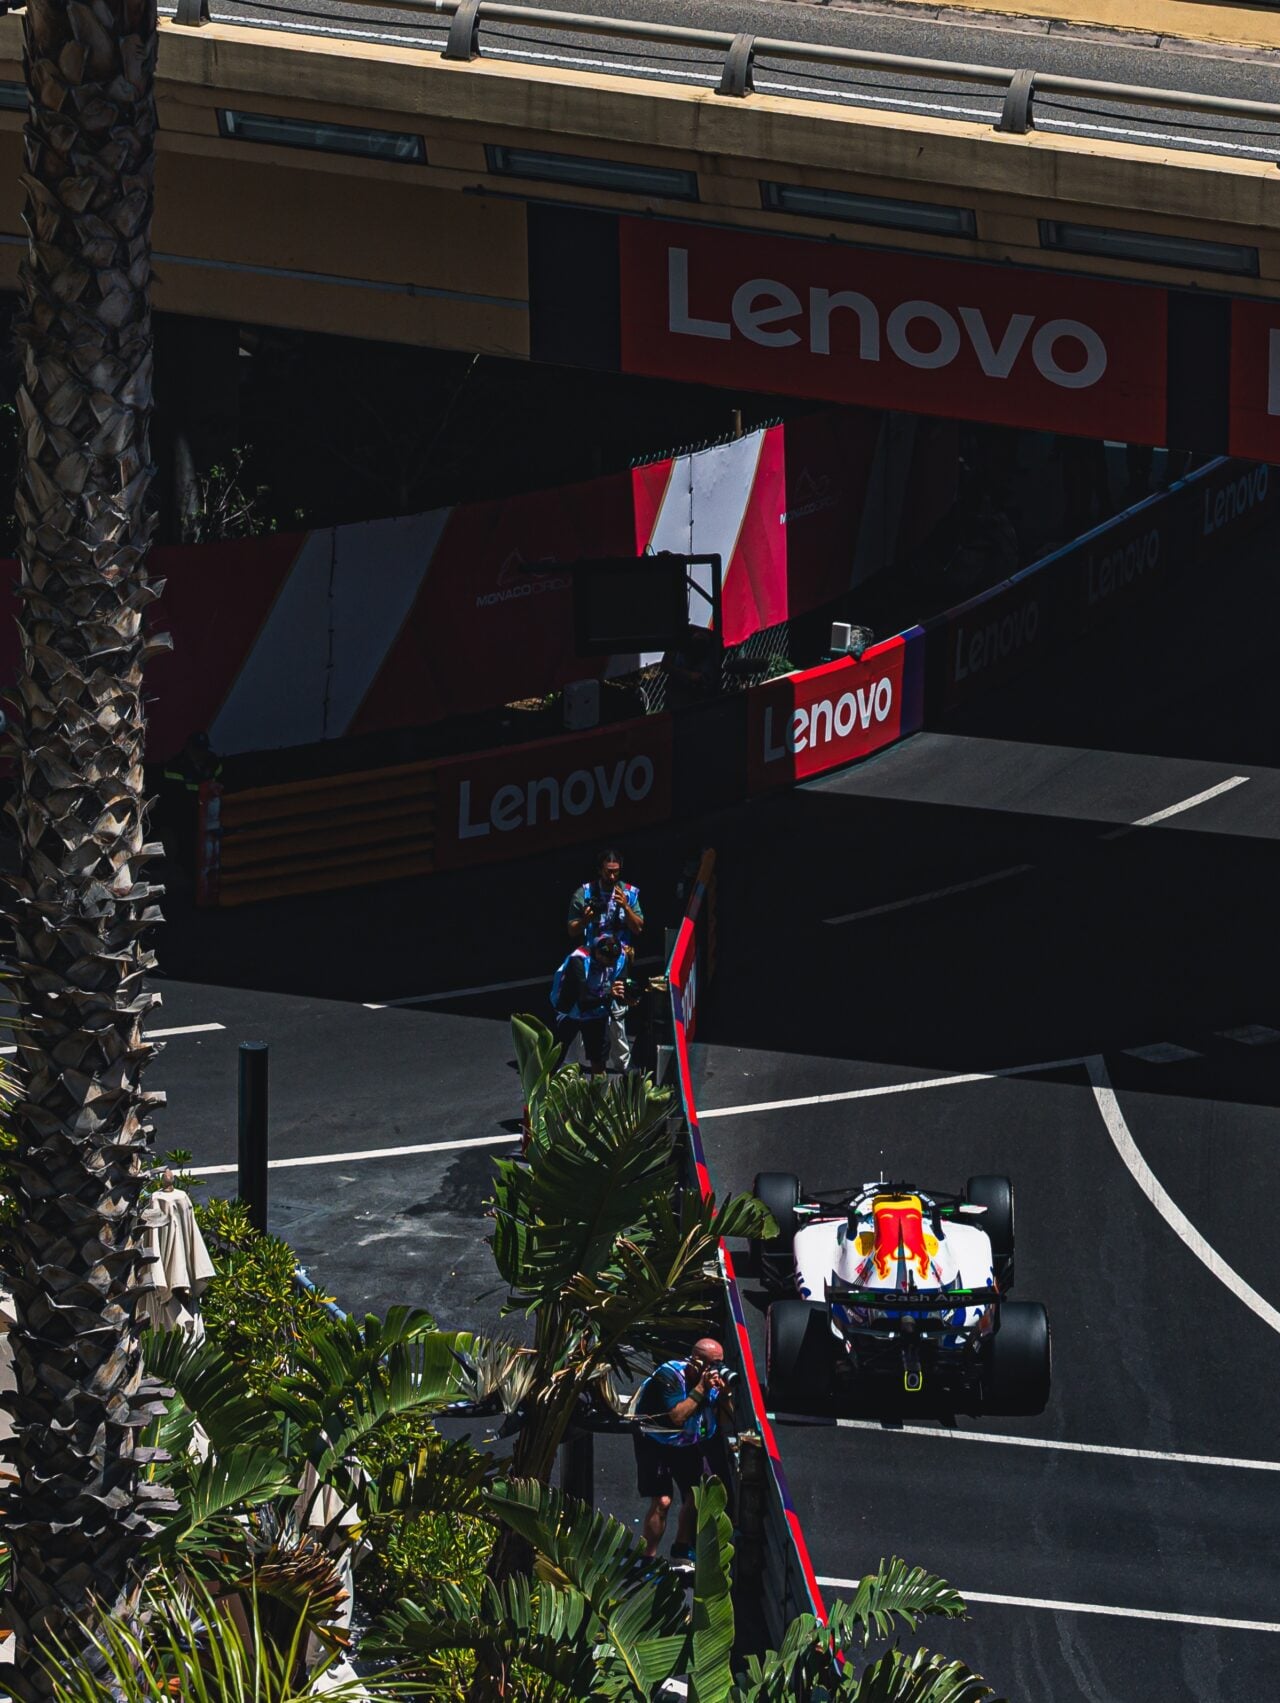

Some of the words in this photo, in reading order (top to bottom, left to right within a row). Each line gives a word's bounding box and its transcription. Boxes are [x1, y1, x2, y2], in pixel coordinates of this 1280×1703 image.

[667, 246, 1108, 389] Lenovo
[1202, 463, 1269, 536] Lenovo
[1087, 527, 1161, 606] Lenovo
[953, 598, 1040, 684] Lenovo
[763, 675, 893, 763] Lenovo
[458, 753, 655, 841] Lenovo
[884, 1292, 930, 1303] Cash
